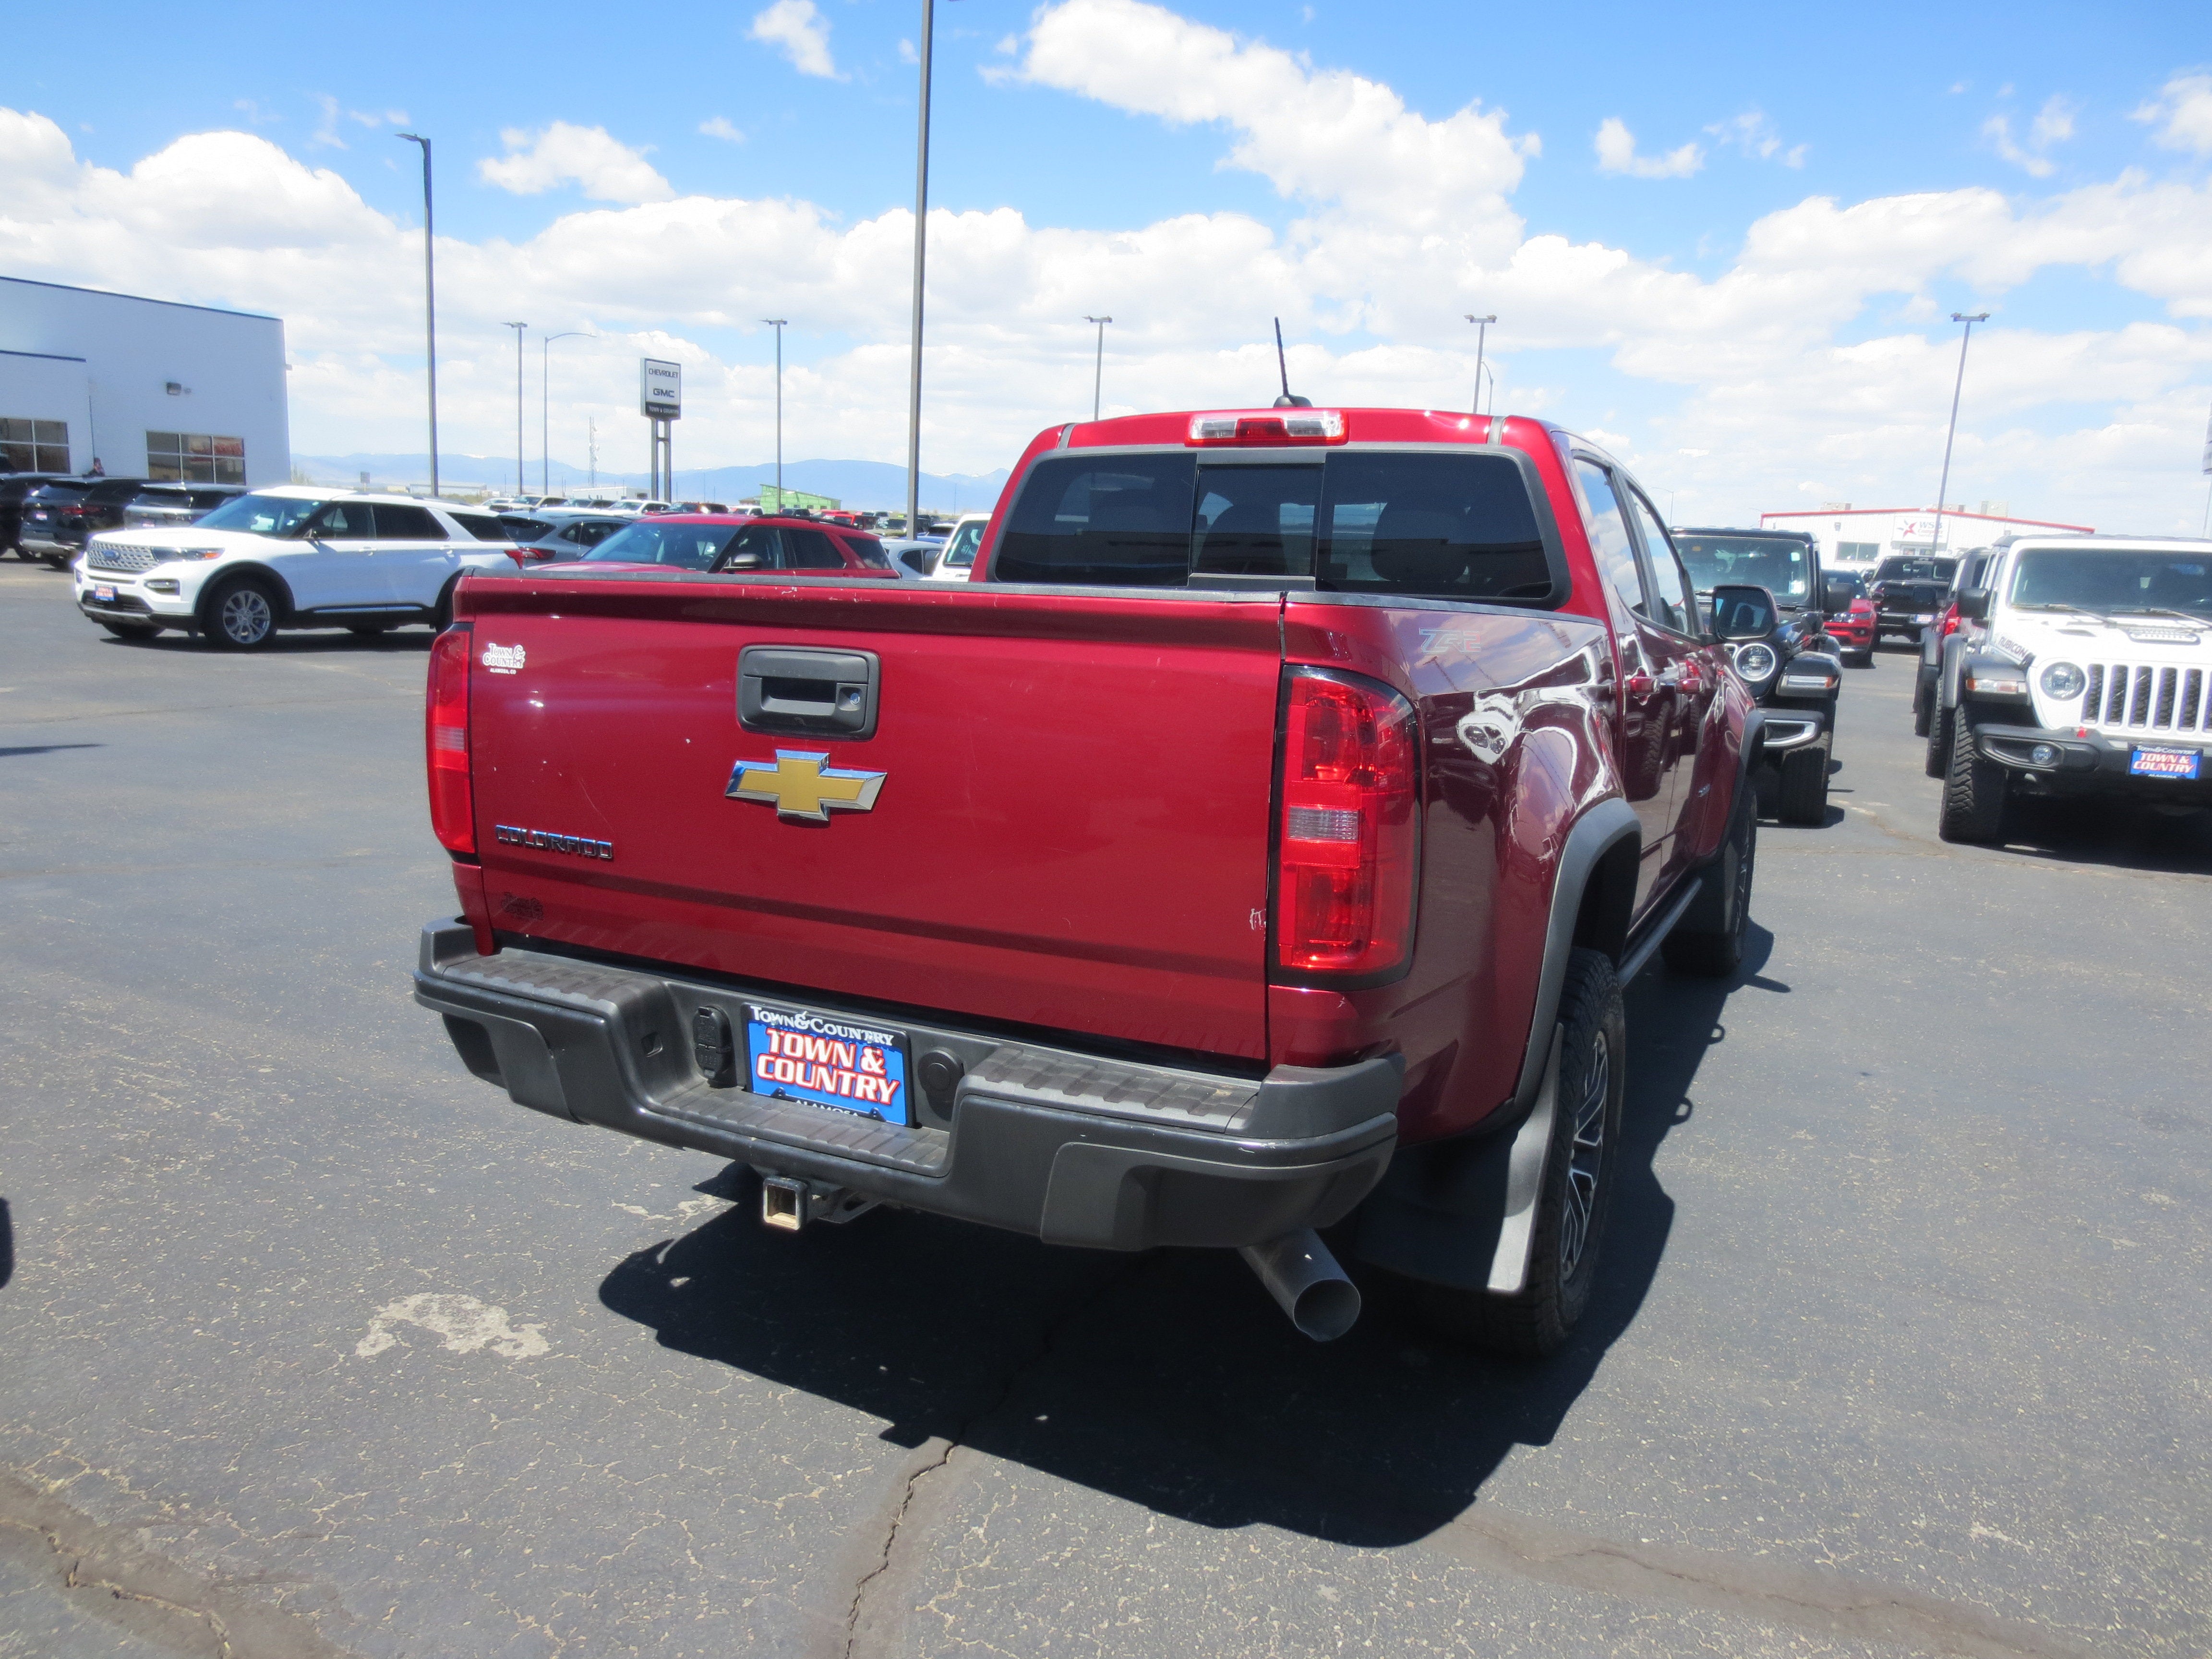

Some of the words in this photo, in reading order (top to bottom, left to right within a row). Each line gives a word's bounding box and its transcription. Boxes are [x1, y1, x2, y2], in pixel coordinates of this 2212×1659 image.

[649, 368, 679, 378] CHEVROLET
[653, 388, 674, 397] GMC
[1419, 627, 1482, 654] ZR2
[1998, 637, 2029, 658] RUBICON
[513, 645, 526, 660] &
[2133, 761, 2195, 773] COUNTRY
[2140, 752, 2178, 763] TOWN
[2179, 755, 2191, 764] &
[496, 824, 613, 859] COLORADO
[766, 1028, 856, 1070] TOWN
[860, 1047, 887, 1075] &
[757, 1053, 900, 1105] COUNTRY
